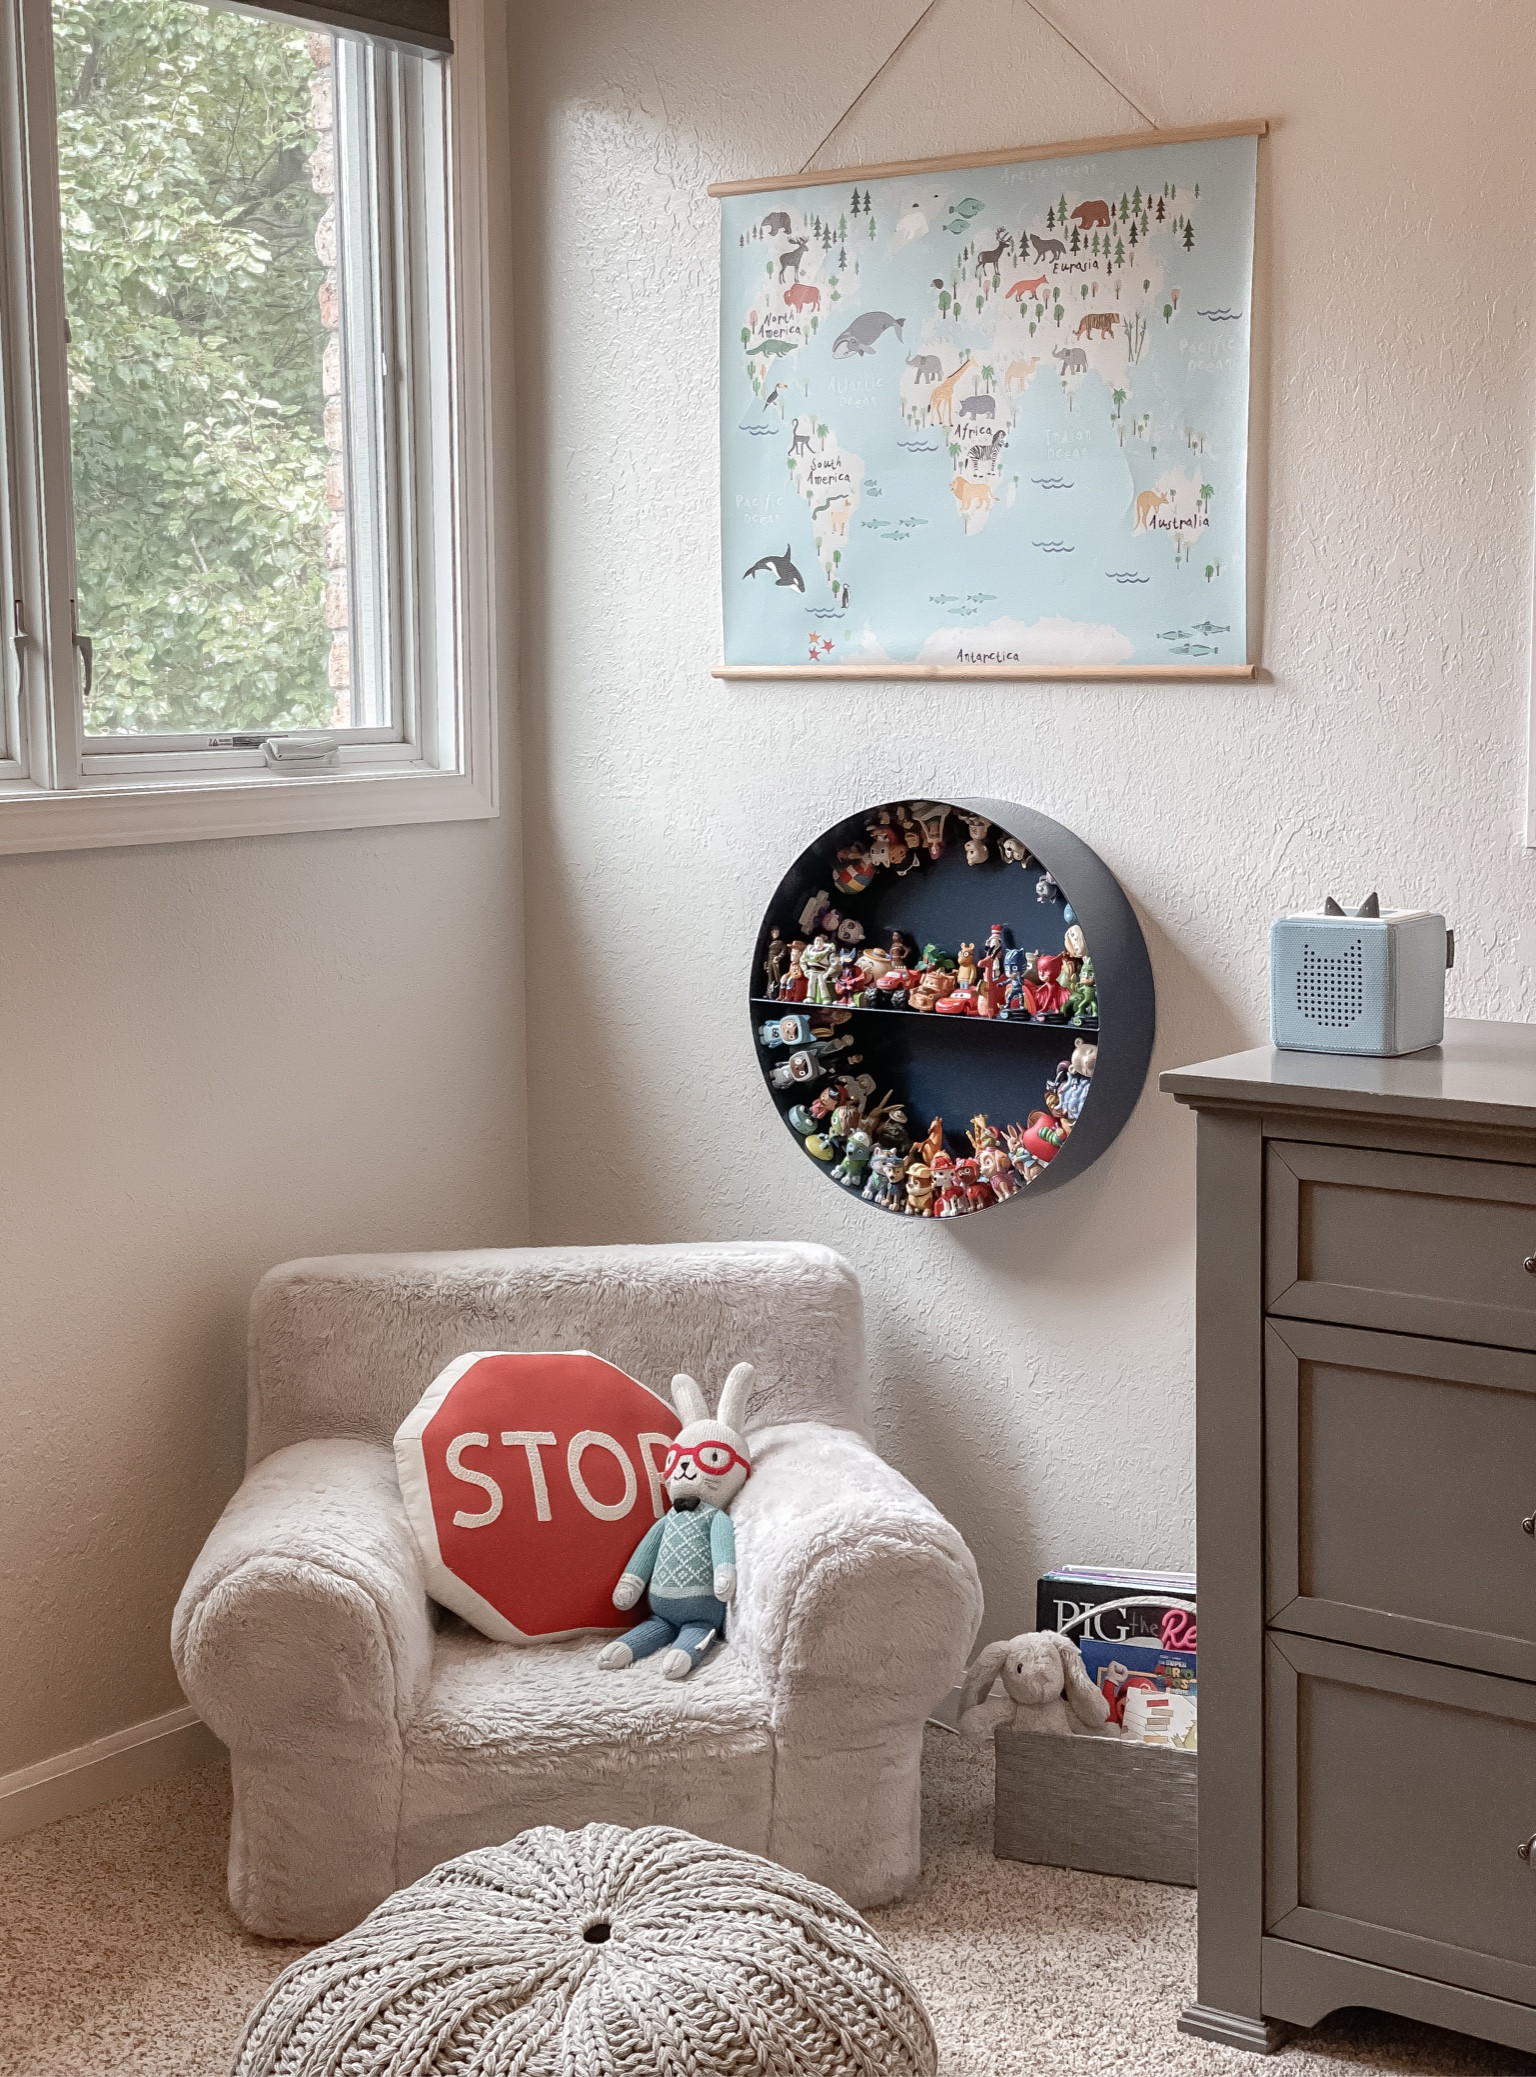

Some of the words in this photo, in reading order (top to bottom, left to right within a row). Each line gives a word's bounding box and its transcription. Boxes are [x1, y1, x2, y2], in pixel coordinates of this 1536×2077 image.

[1052, 259, 1099, 274] Eurasia
[763, 311, 794, 325] North
[758, 324, 801, 338] America
[954, 424, 993, 440] Africa
[810, 458, 842, 472] South
[806, 471, 851, 486] America
[1148, 514, 1211, 530] Australia
[956, 648, 1019, 663] Antarctica
[1053, 1599, 1130, 1643] PIG
[1129, 1611, 1159, 1637] the
